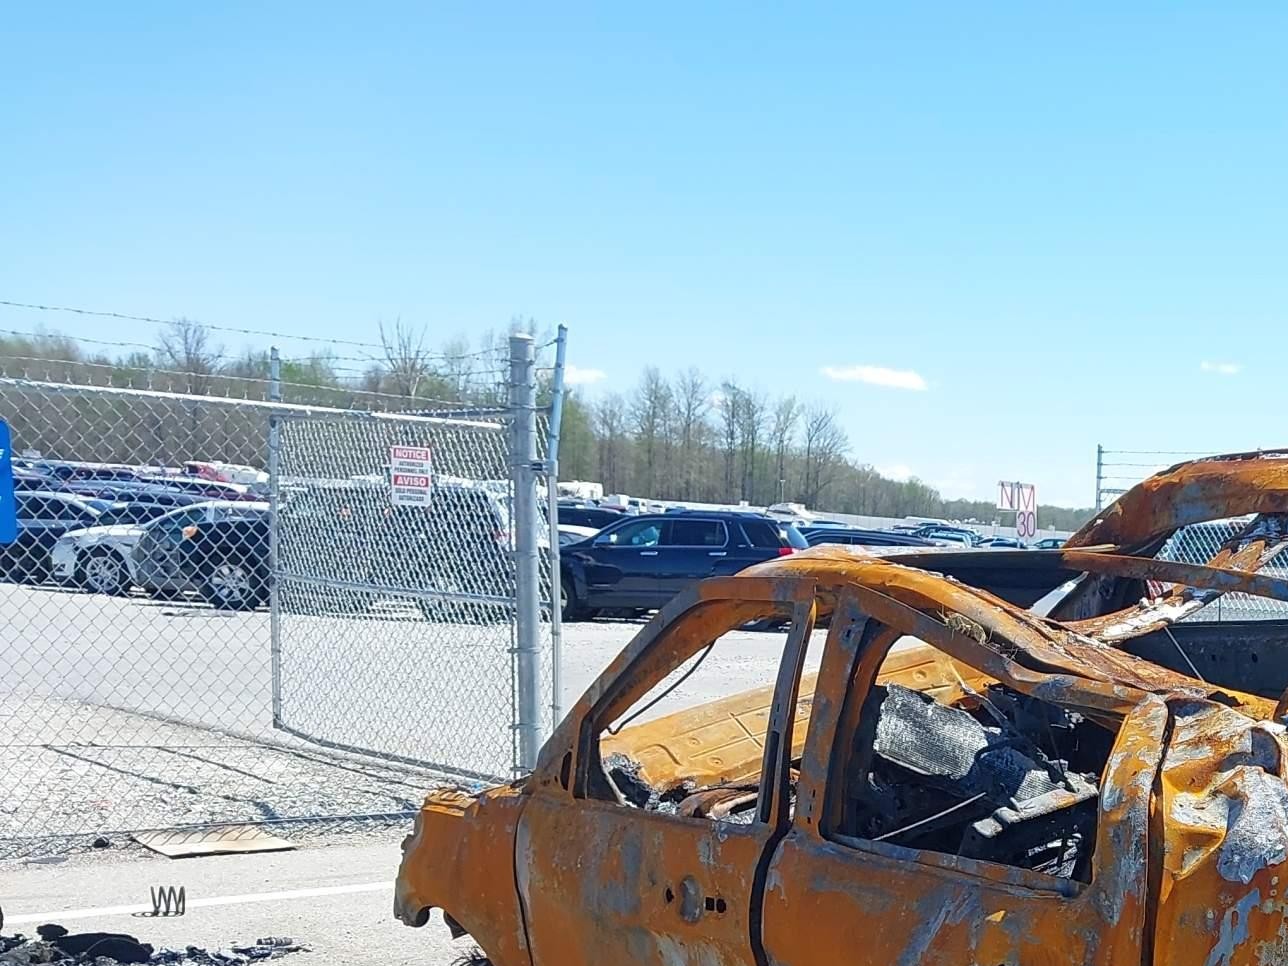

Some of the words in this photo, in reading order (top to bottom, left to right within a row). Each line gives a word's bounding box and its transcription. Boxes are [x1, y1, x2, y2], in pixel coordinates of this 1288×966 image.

[395, 448, 427, 460] NOTICE
[396, 476, 427, 487] AVISO
[1017, 511, 1036, 537] 30
